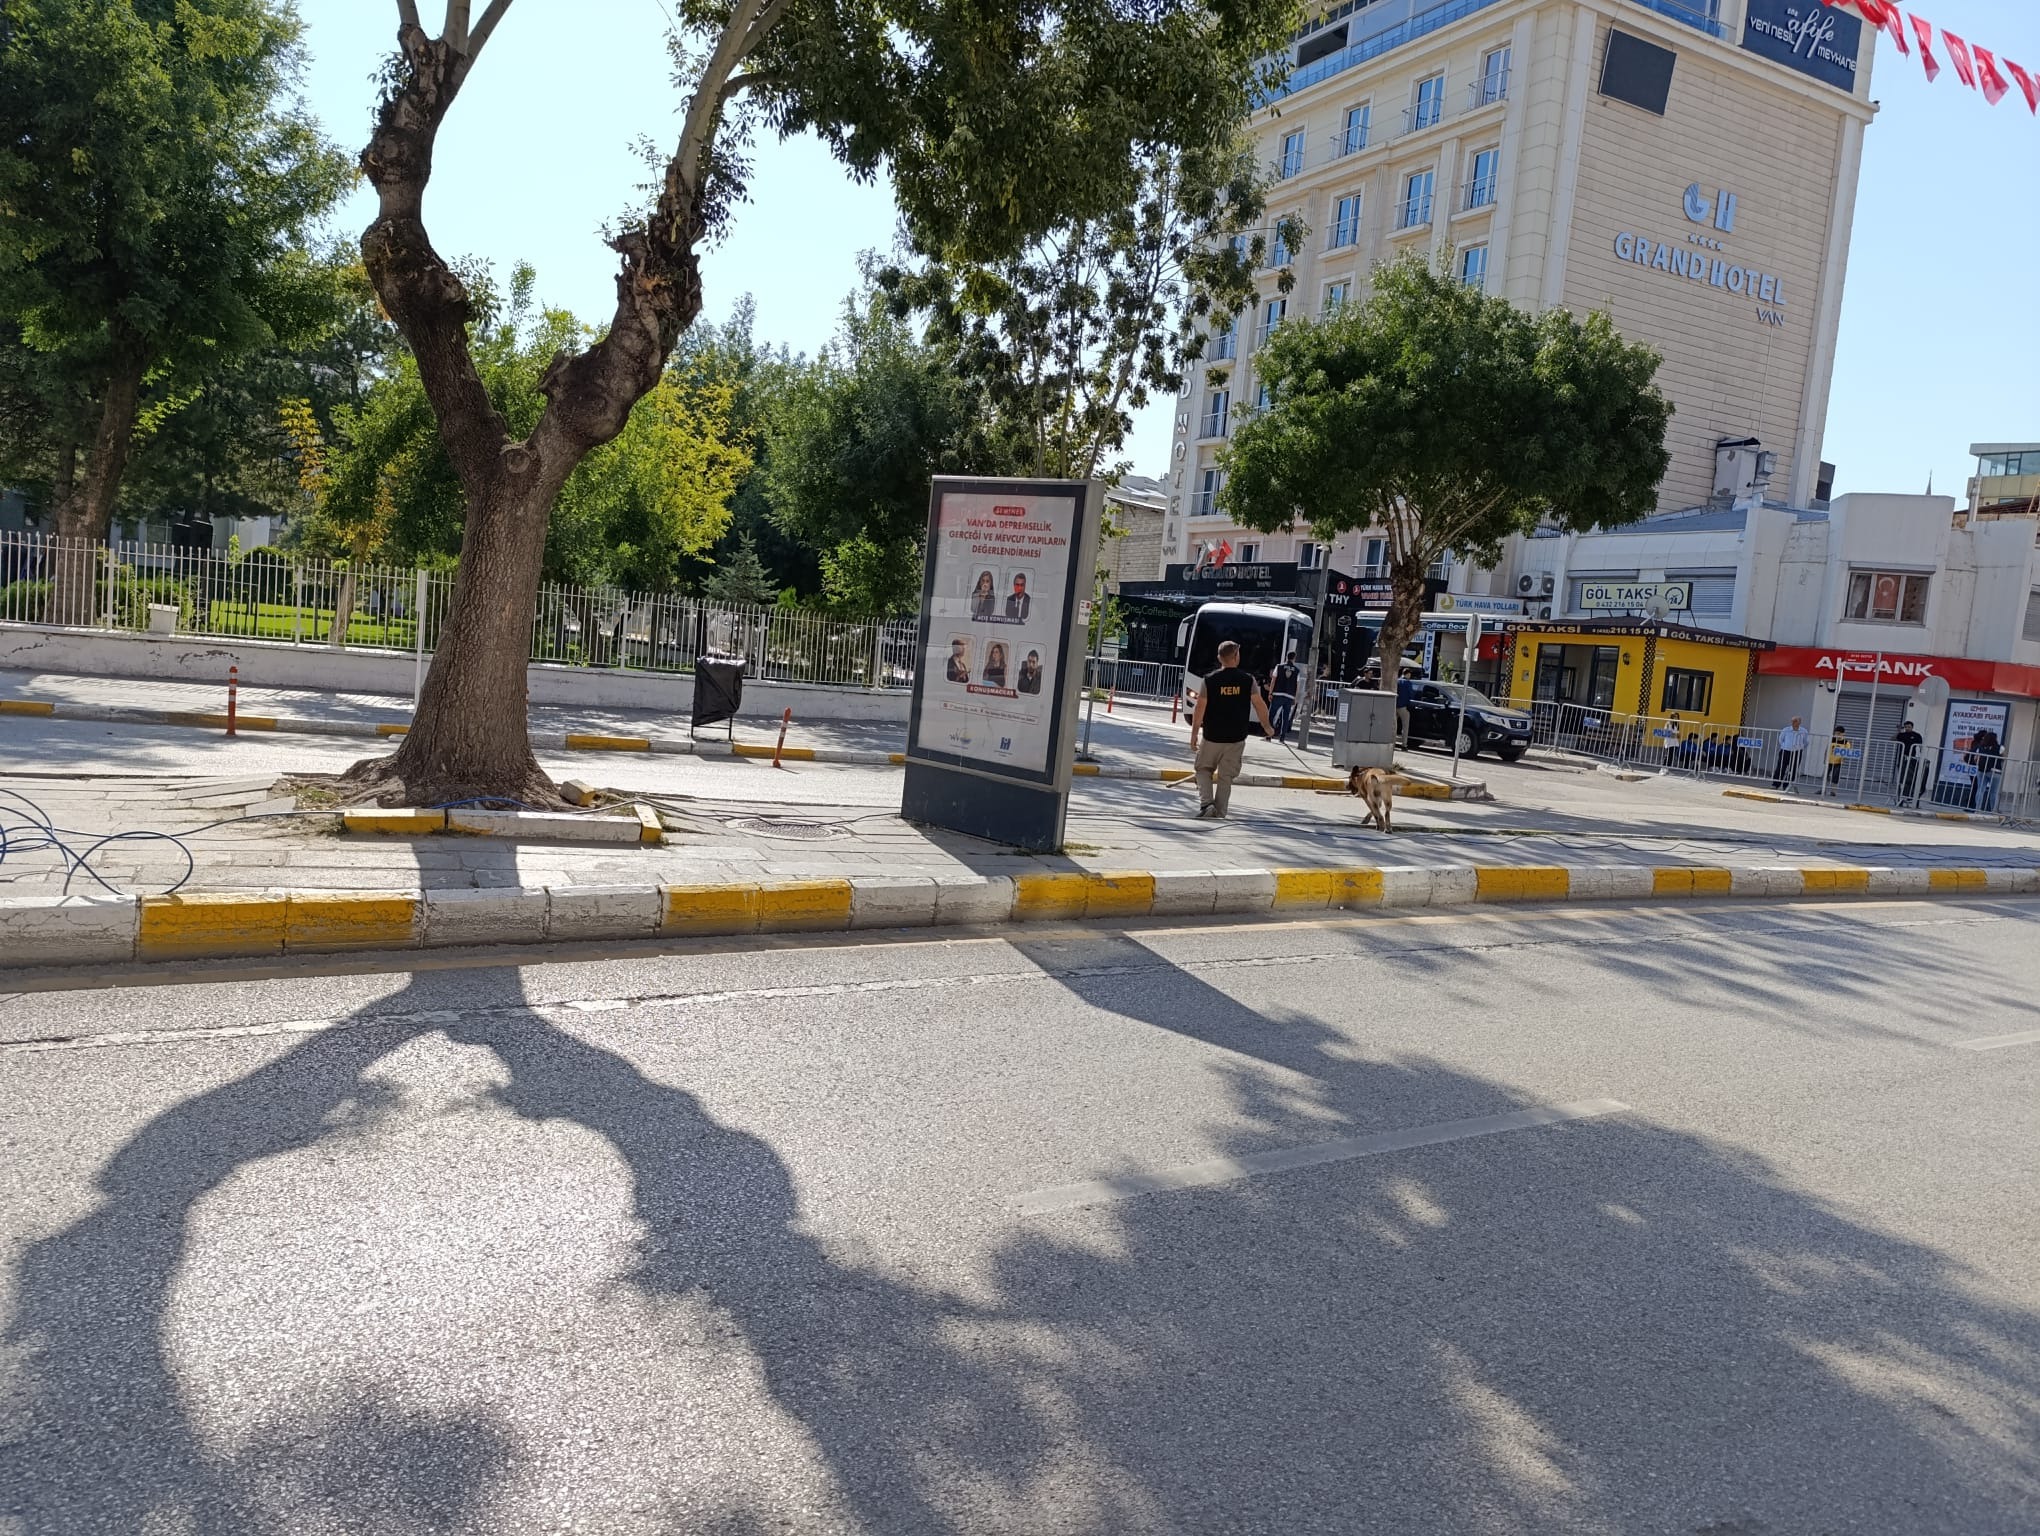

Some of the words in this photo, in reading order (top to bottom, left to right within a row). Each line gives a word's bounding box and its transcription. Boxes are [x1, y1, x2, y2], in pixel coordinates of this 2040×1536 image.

[1788, 9, 1834, 58] afife
[1818, 46, 1857, 71] MEYHANE
[1614, 231, 1706, 280] GRAND
[1710, 258, 1787, 305] HOTEL
[1755, 307, 1784, 327] VAN
[967, 518, 997, 529] VAN'DA
[999, 520, 1052, 532] DEPREMSELLİK
[949, 530, 981, 542] GERÇEĞİ
[983, 532, 993, 541] VE
[995, 533, 1025, 543] MEVCUT
[1027, 535, 1067, 546] YAPILARIN
[972, 544, 1041, 558] DEĞERLENDİRMESİ
[1237, 566, 1272, 579] HOTEL
[1329, 593, 1349, 605] THY
[1585, 586, 1613, 600] GÖL
[1617, 585, 1658, 600] TAKSİ
[1456, 599, 1472, 608] TÜRK
[1474, 600, 1491, 609] HAVA
[1492, 601, 1519, 610] YOLLARI
[1422, 621, 1447, 629] Coffee
[1506, 624, 1534, 632] GÖL
[1539, 625, 1581, 633] TAKSİ
[1671, 631, 1691, 640] GÖL
[1694, 634, 1724, 645] TAKSİ
[1220, 686, 1240, 695] KEM
[1737, 738, 1762, 747] POLİS
[1834, 748, 1860, 758] POLİS
[1949, 763, 1977, 775] POLİS
